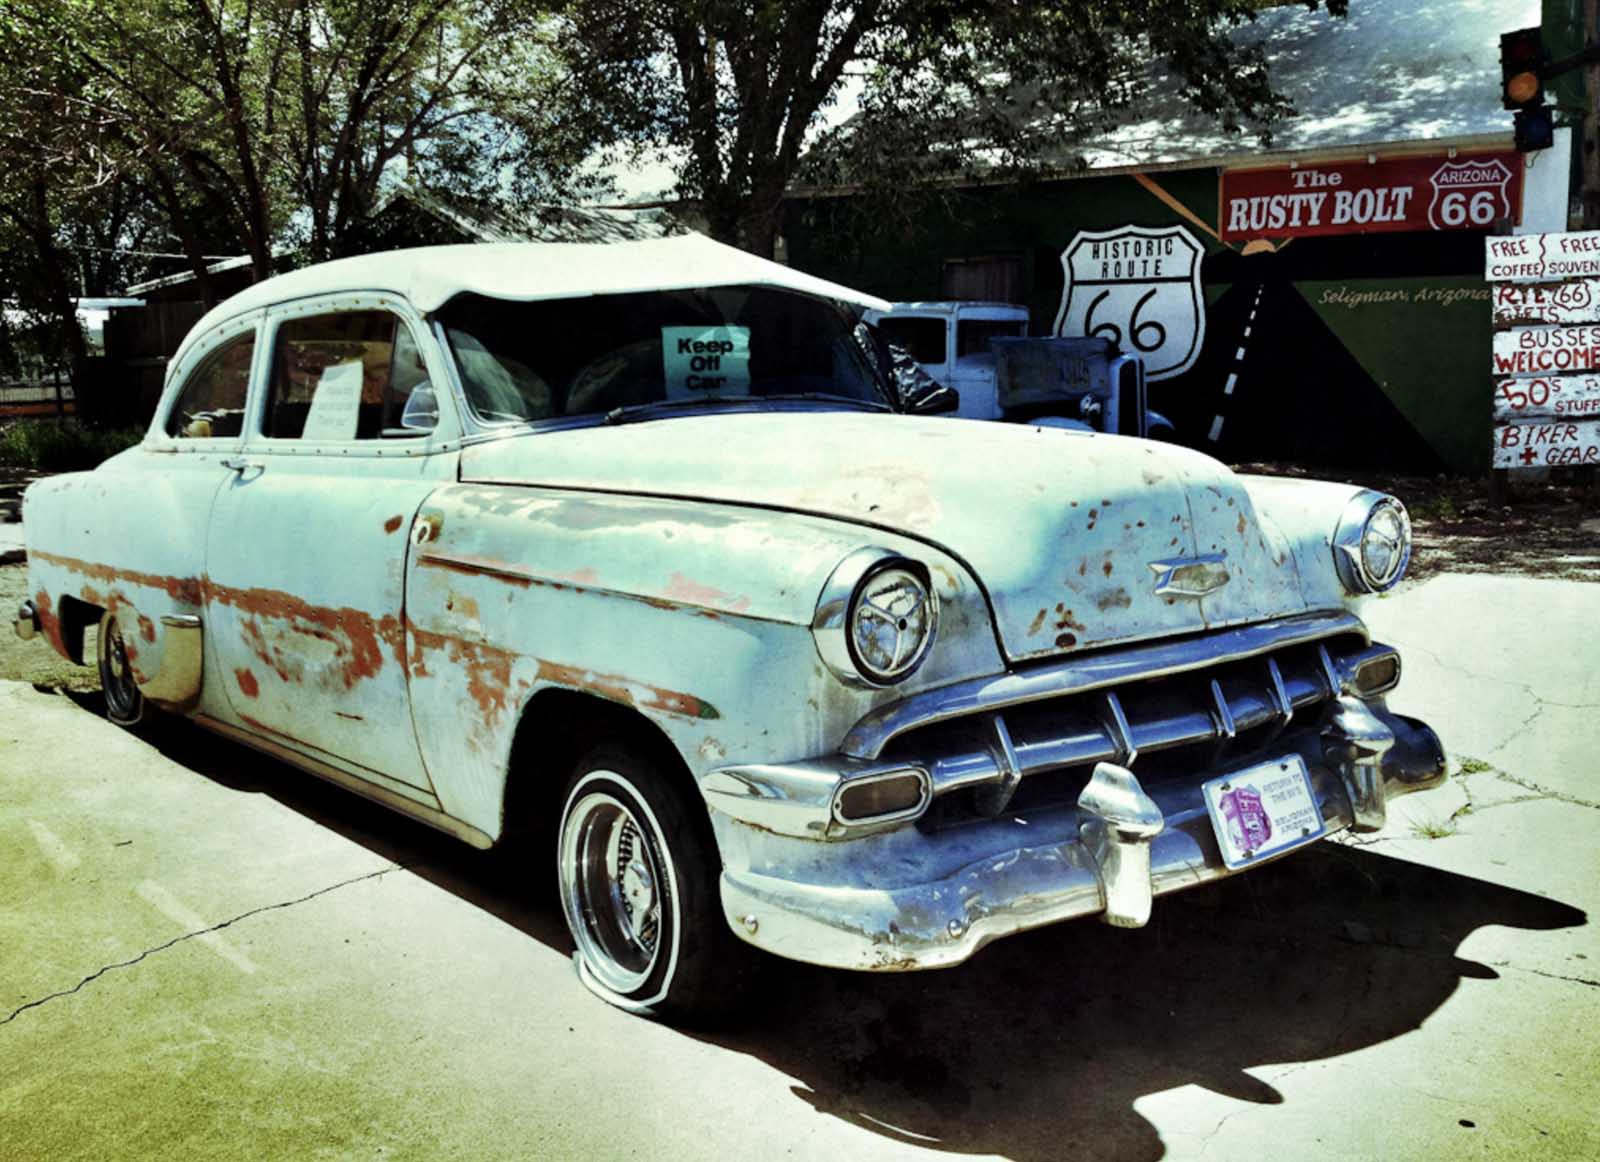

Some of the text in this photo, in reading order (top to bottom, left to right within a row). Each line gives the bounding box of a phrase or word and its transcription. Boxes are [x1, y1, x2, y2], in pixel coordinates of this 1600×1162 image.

[1292, 170, 1342, 188] The
[1439, 169, 1501, 184] ARIZONA
[1227, 187, 1413, 232] RUSTY BOLT
[1440, 191, 1496, 226] 66
[1092, 239, 1174, 259] HISTORIC
[1491, 240, 1529, 257] FREE
[1560, 236, 1600, 253] FREE
[1101, 259, 1163, 278] ROUTE
[1491, 263, 1540, 277] COFFEE
[1414, 287, 1490, 306] Arizona
[1560, 285, 1584, 303] 66
[1084, 288, 1166, 352] 66
[677, 338, 734, 355] Keep
[1520, 328, 1600, 348] BUSSES
[1494, 347, 1600, 373] WELCOME
[1501, 425, 1578, 448] BIKER
[1546, 446, 1598, 465] GEAR
